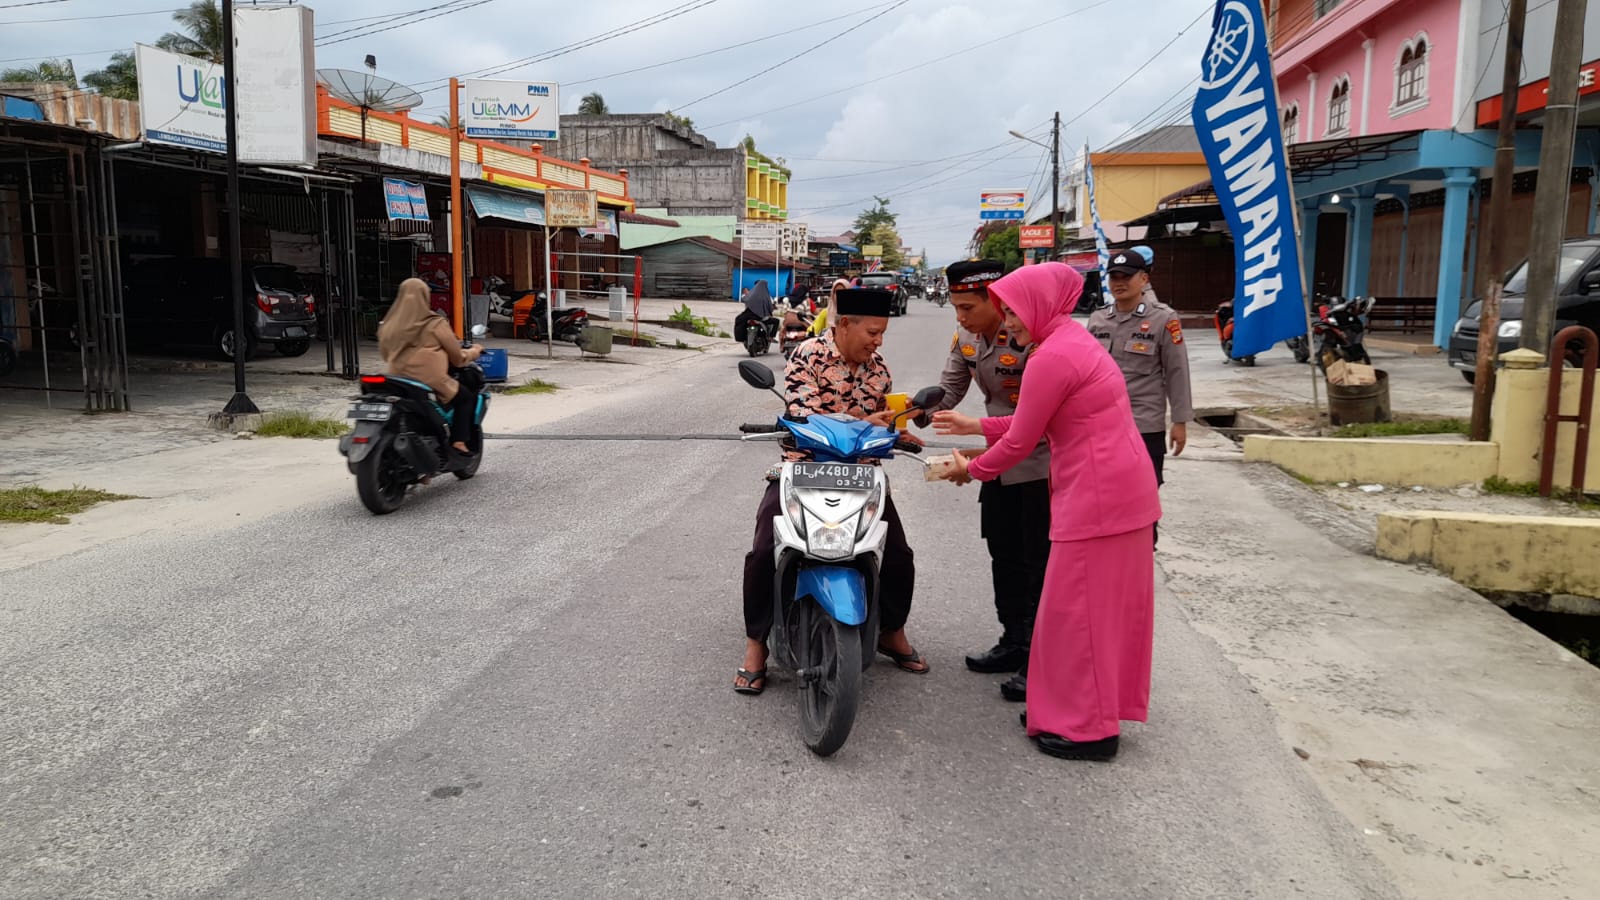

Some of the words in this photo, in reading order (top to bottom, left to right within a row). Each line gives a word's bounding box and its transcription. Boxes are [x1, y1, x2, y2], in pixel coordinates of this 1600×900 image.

[528, 85, 549, 94] PNM
[472, 102, 530, 116] ULaMM
[1205, 62, 1284, 318] YAMAHA
[1131, 333, 1155, 341] POLRI
[794, 465, 809, 475] BL
[817, 466, 849, 476] 4480
[856, 467, 871, 477] RK
